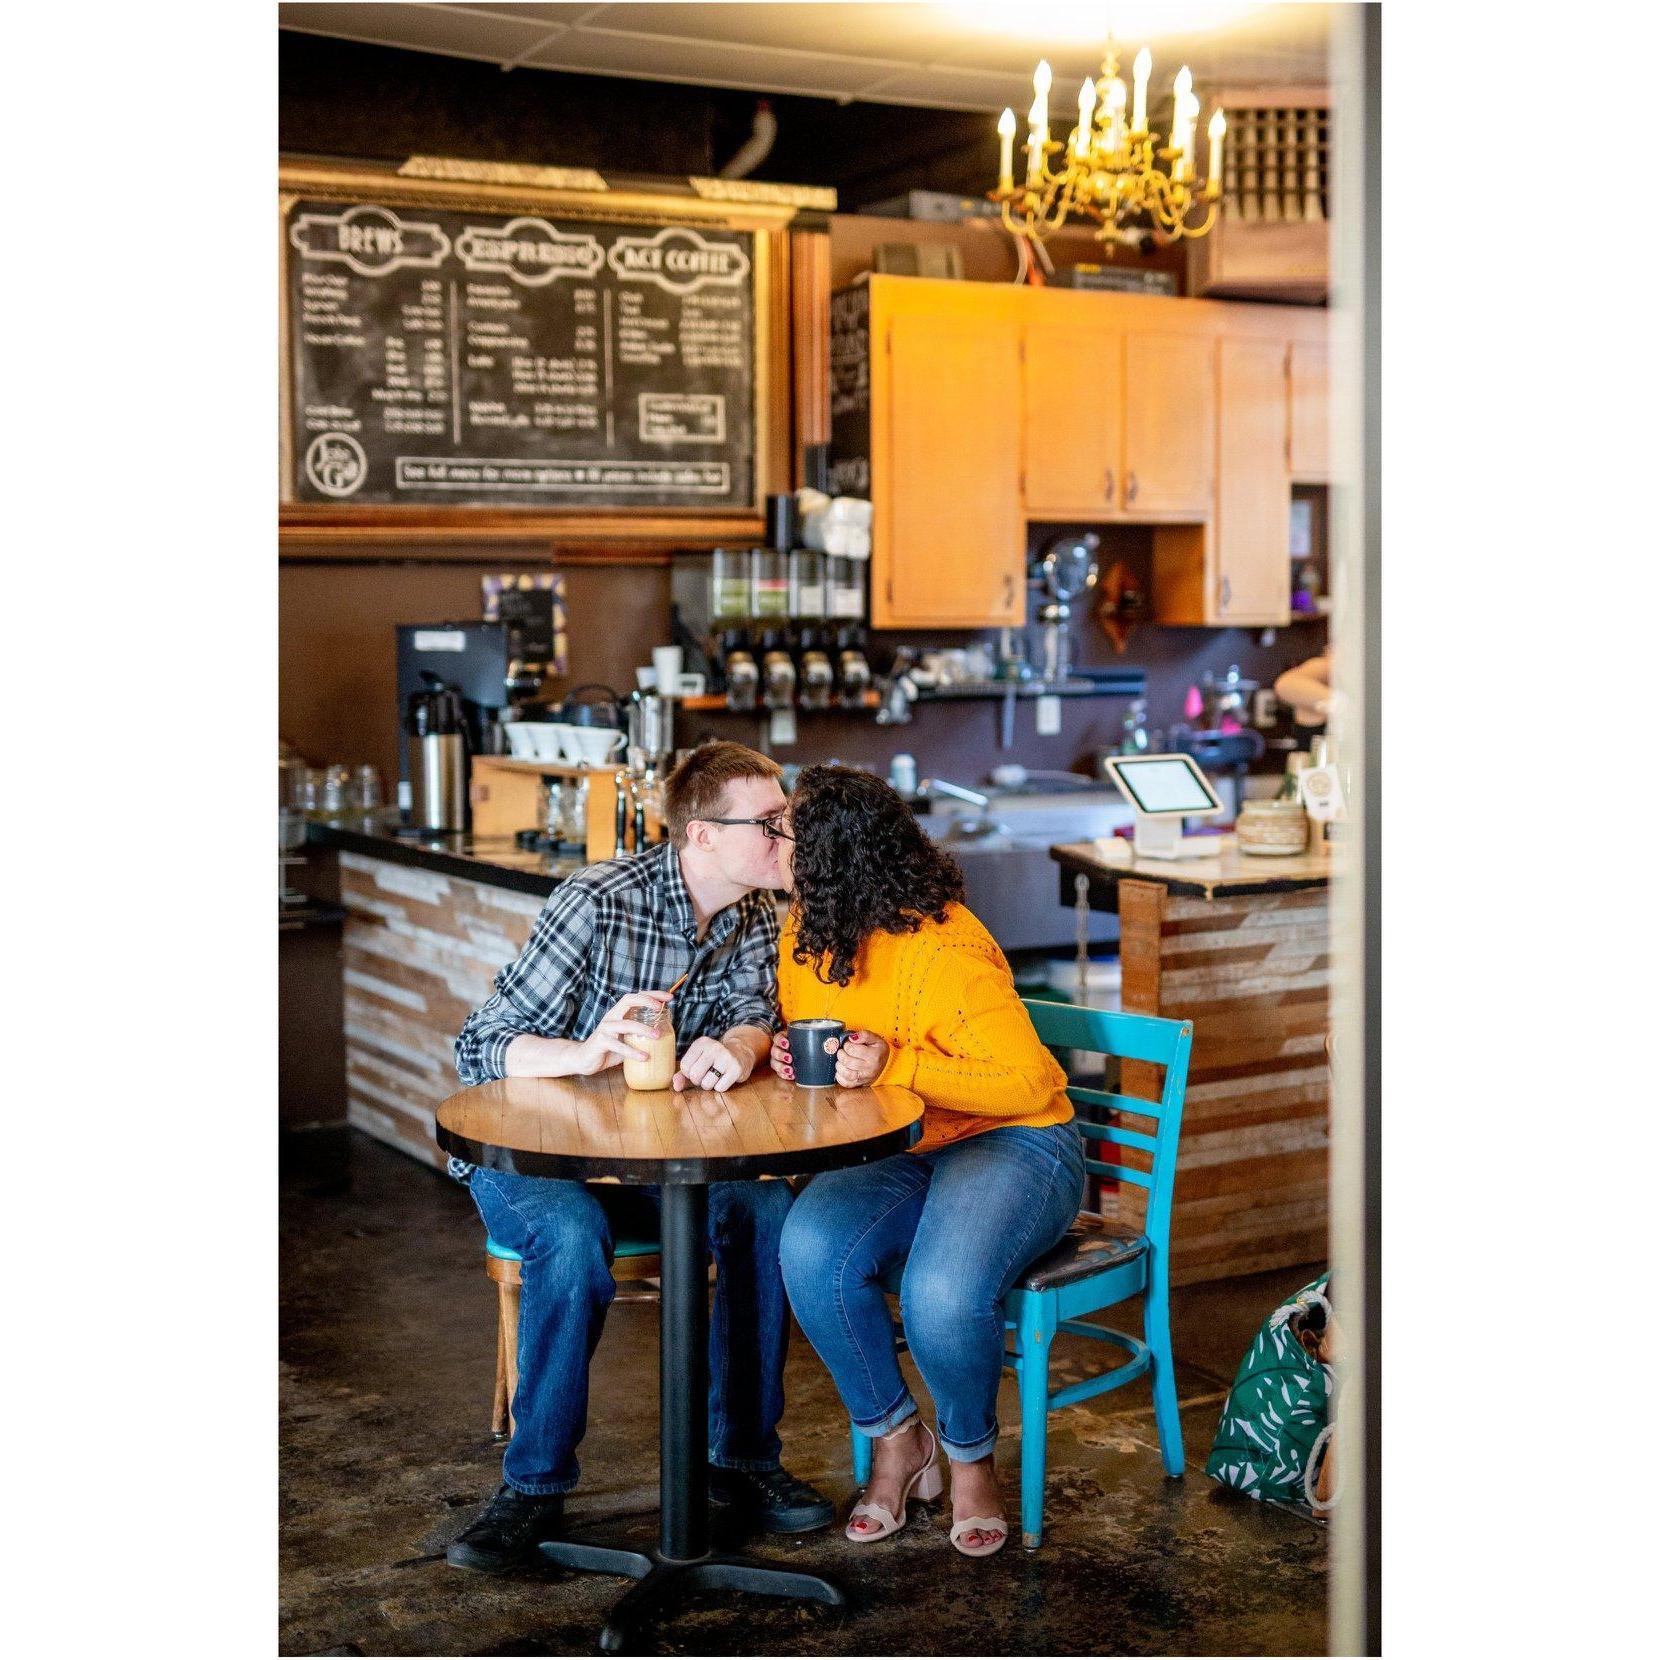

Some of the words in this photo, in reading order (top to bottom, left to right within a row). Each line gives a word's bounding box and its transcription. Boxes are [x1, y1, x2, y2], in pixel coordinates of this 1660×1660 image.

[338, 224, 402, 253] BREWS
[473, 238, 595, 265] ESPRESSO
[665, 249, 729, 274] COFFEE
